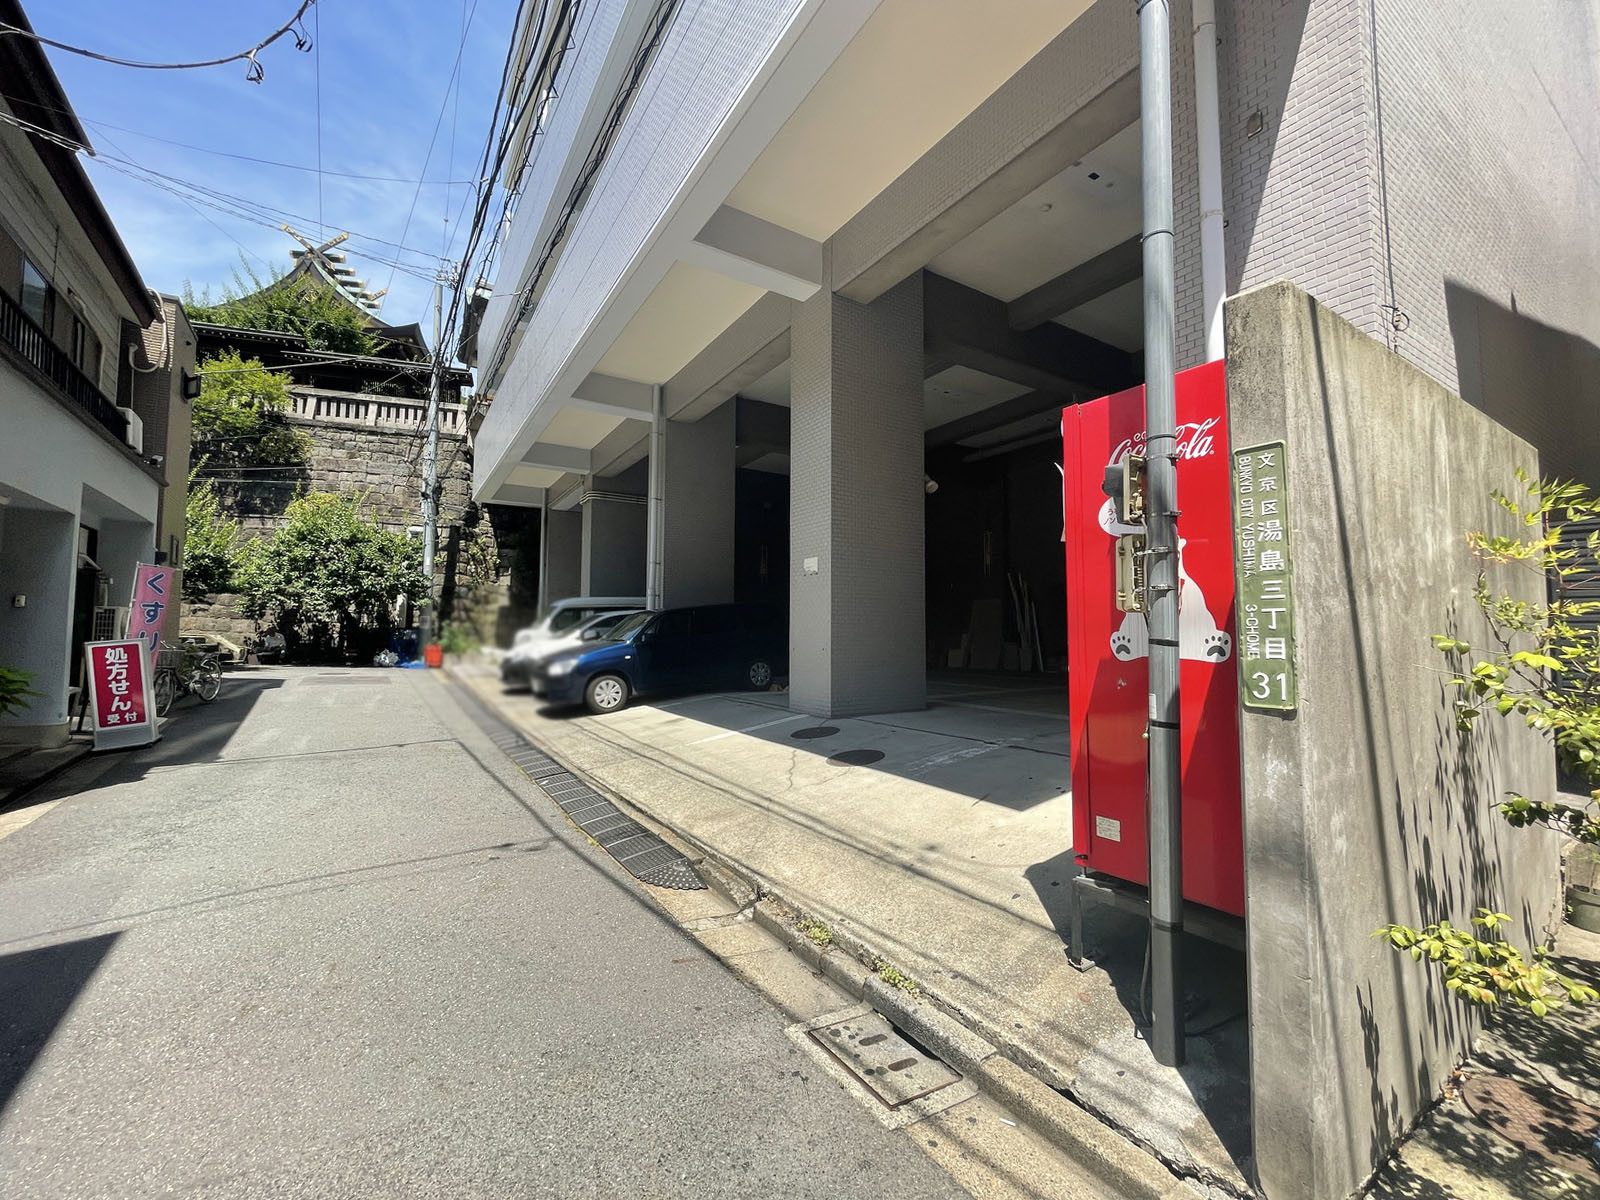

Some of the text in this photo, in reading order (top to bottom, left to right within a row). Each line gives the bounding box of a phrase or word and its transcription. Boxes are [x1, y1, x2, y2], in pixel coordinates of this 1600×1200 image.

[1239, 455, 1261, 660] BUNKYO CITY YUSHIMA 3-CHOME
[1252, 452, 1287, 701] 文京区湯島三丁目 31
[138, 573, 165, 651] くすり
[104, 647, 132, 712] 処方せん
[106, 711, 138, 725] 受付
